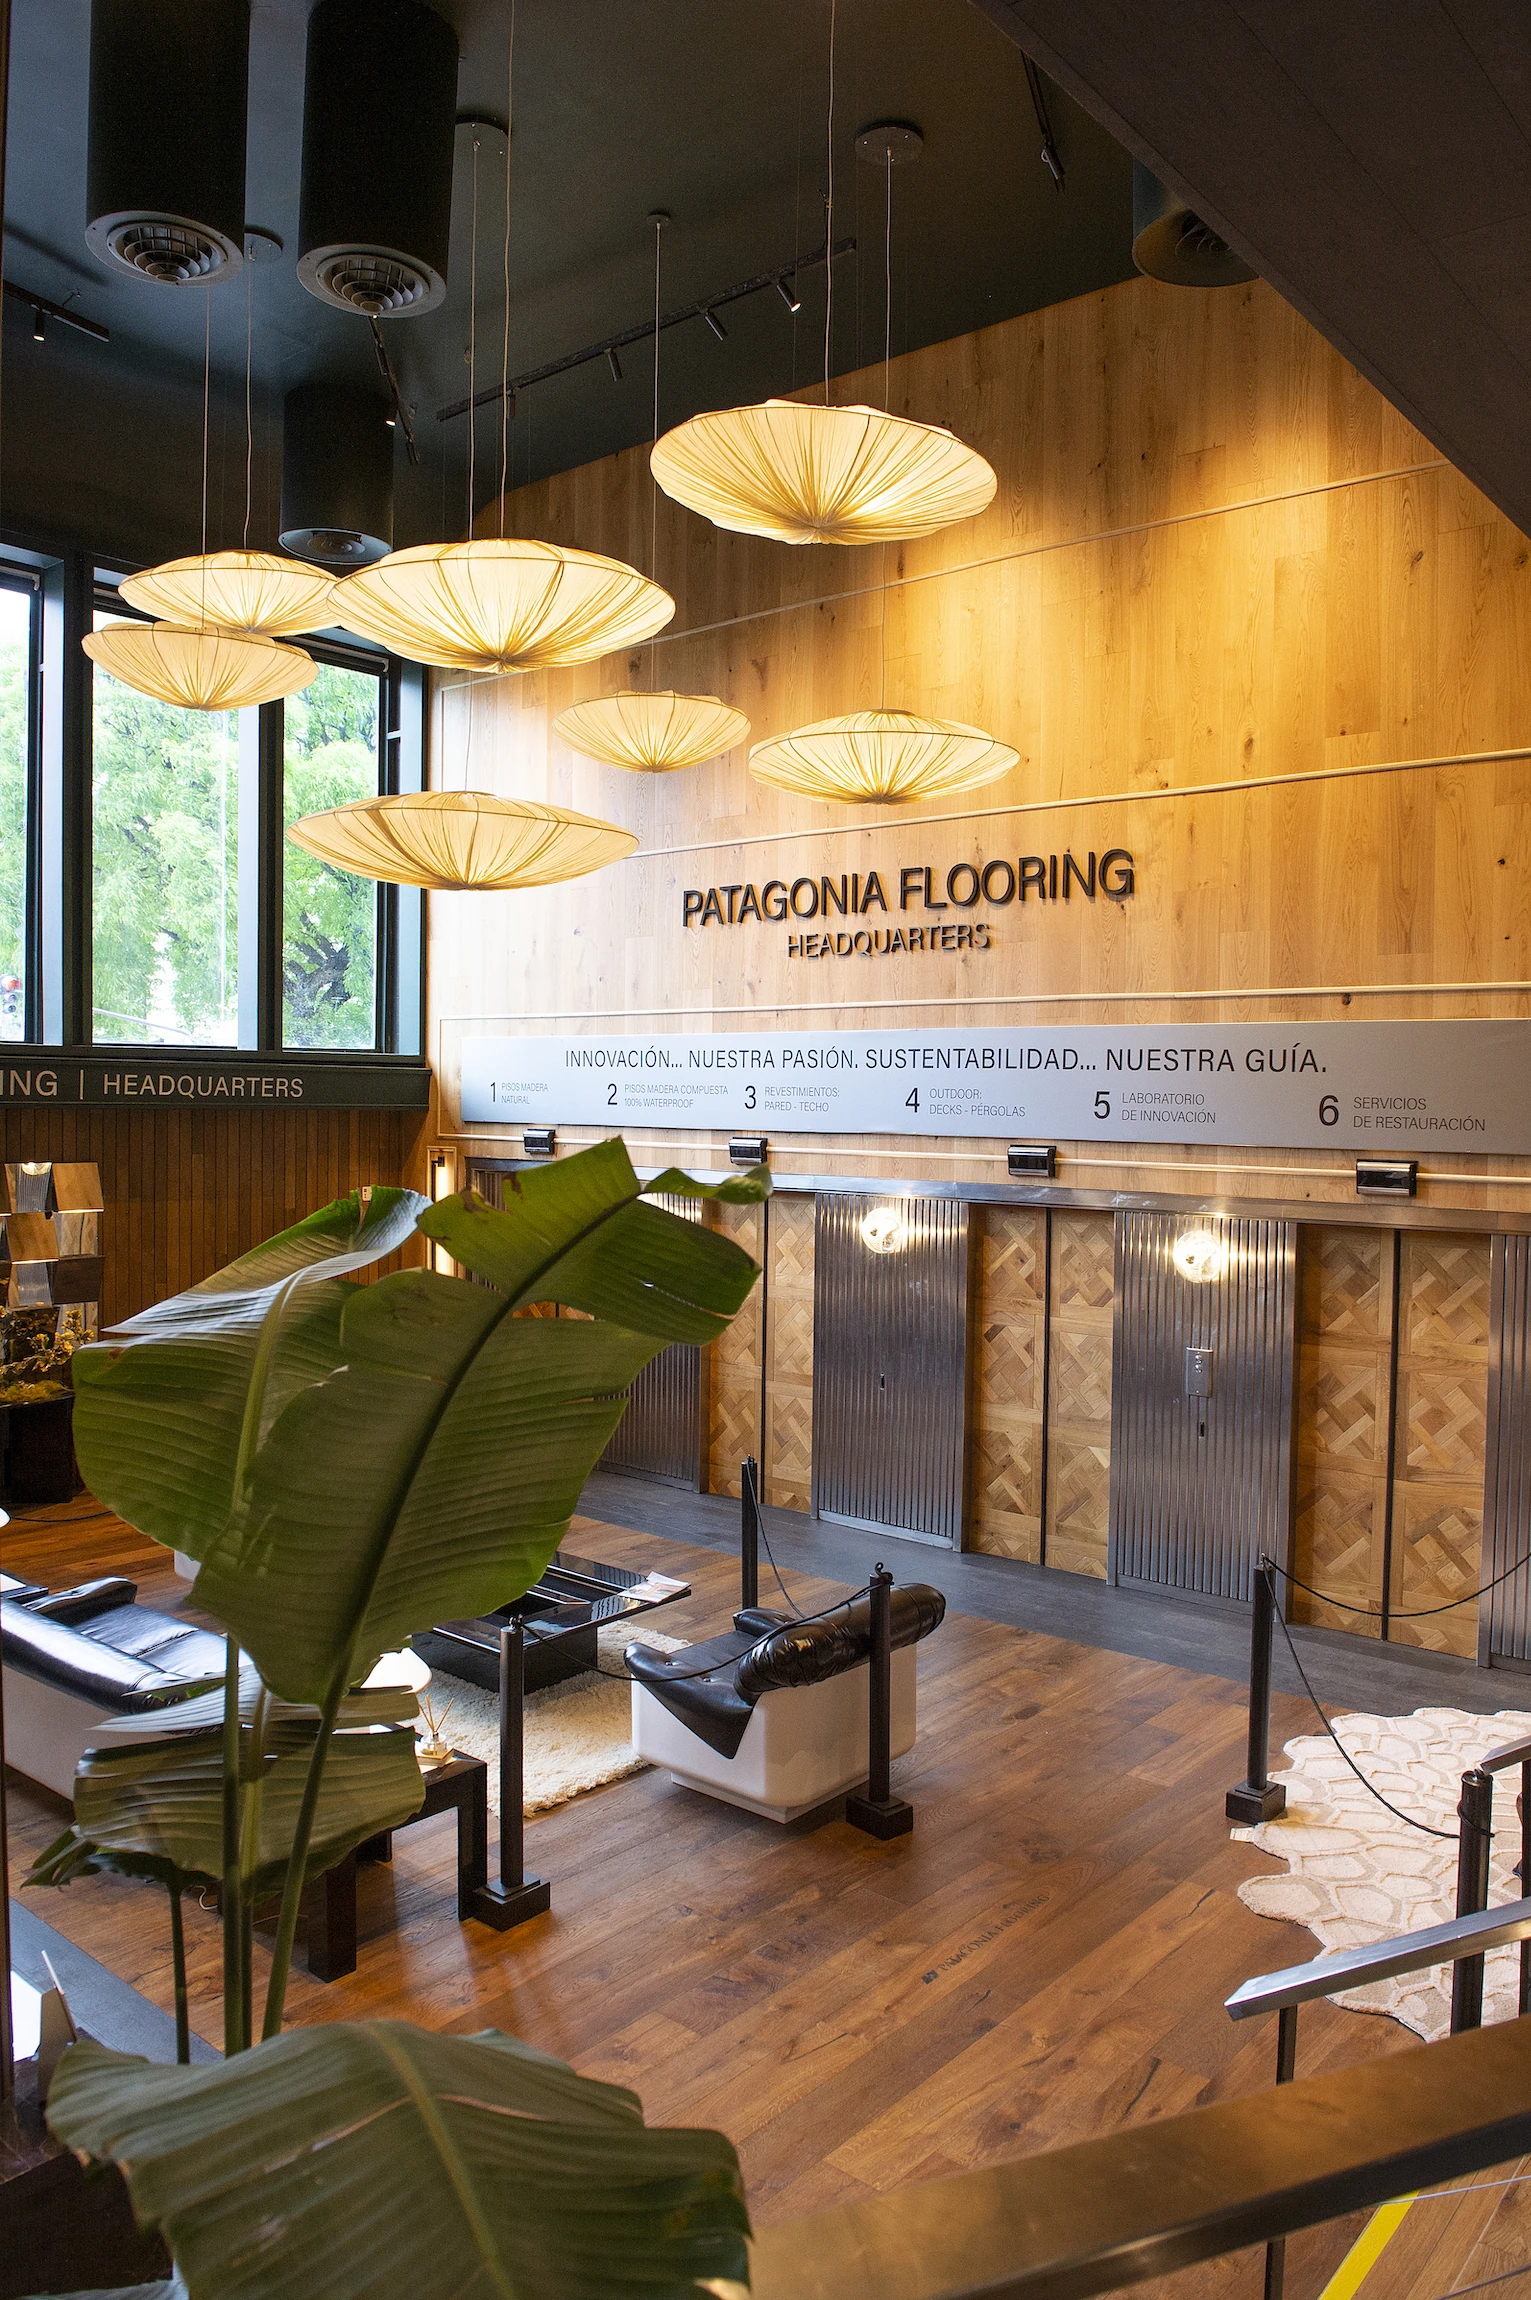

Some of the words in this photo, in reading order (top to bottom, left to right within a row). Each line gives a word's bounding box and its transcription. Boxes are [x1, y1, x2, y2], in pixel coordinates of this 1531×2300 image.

[682, 871, 888, 928] PATAGONIA
[899, 848, 1135, 911] FLOORING
[788, 922, 992, 959] HEADQUARTERS
[565, 1045, 683, 1069] INNOVACIÓN...
[688, 1049, 775, 1069] NUESTRA
[782, 1045, 858, 1069] PASIÓN.
[865, 1048, 1096, 1071] SUSTENTABILIDAD...
[1106, 1048, 1236, 1072] NUESTRA
[1245, 1042, 1327, 1073] GUÍA.
[103, 1073, 304, 1099] HEADQUARTERS
[490, 1081, 496, 1103] 1
[501, 1082, 521, 1092] PISOS
[521, 1083, 549, 1092] MADERA
[607, 1083, 618, 1106] 2
[624, 1084, 646, 1094] PISOS
[646, 1084, 679, 1094] MADERA
[680, 1085, 729, 1095] COMPUESTA
[764, 1086, 840, 1098] REVESTIMIENTOS:
[929, 1088, 982, 1100] OUTDOOR:
[501, 1095, 530, 1104] NATURAL
[624, 1098, 643, 1107] 100%
[643, 1098, 694, 1109] WATERPROOF
[744, 1085, 757, 1110] 3
[905, 1087, 920, 1113] 4
[1093, 1090, 1111, 1120] 5
[1121, 1092, 1205, 1106] LABORATORIO
[1353, 1096, 1427, 1111] SERVICIOS
[764, 1101, 792, 1111] PARED
[799, 1101, 830, 1112] TECHO
[929, 1104, 963, 1116] DECKS
[970, 1102, 1026, 1117] PÉRGOLAS
[1318, 1094, 1340, 1127] 6
[1121, 1109, 1137, 1121] DE
[1140, 1108, 1216, 1124] INNOVACIÓN
[1353, 1115, 1372, 1128] DE
[1375, 1115, 1486, 1132] RESTAURACIÓN
[938, 1930, 1000, 1972] PATAGONIA
